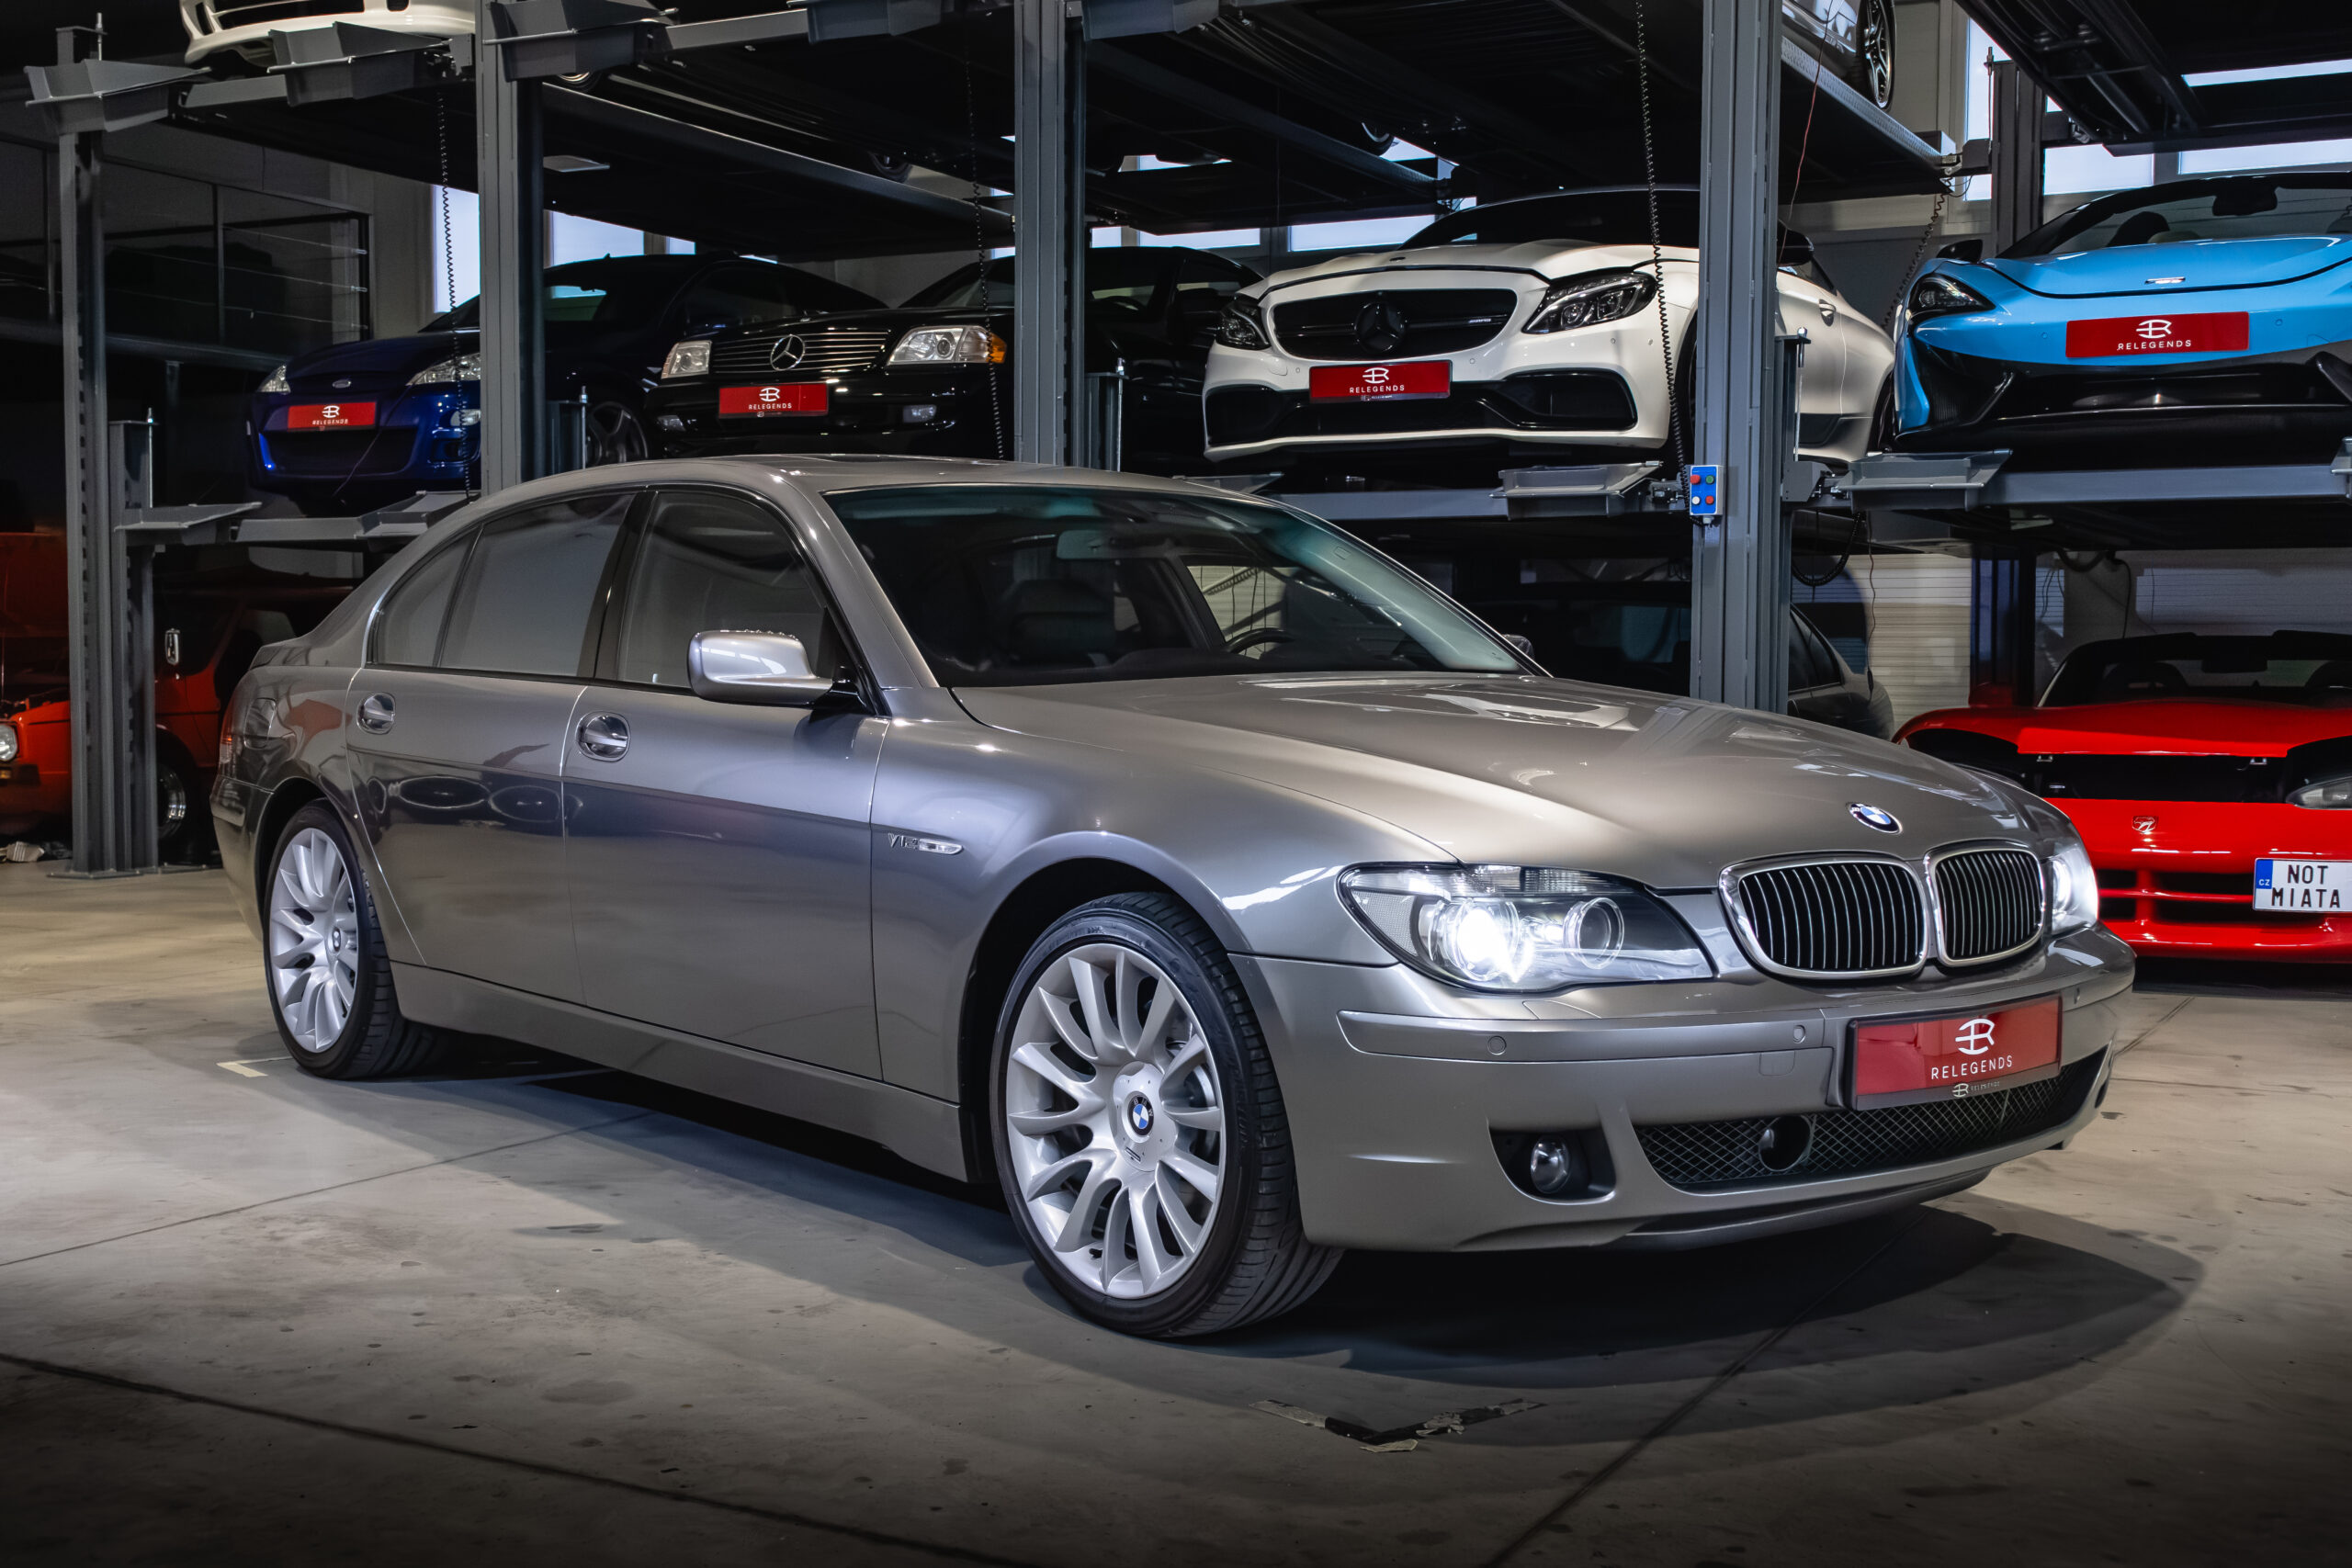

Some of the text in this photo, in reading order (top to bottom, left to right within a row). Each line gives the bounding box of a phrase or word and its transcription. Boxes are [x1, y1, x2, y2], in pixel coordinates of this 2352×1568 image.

[2117, 339, 2192, 351] RELEGENDS
[1349, 384, 1406, 394] RELEGENDS
[748, 402, 792, 411] RELEGENDS
[2258, 878, 2270, 886] CZ
[2287, 864, 2328, 885] NOT
[2271, 886, 2340, 908] MIATA
[1931, 1055, 2013, 1080] RELEGENDS
[1133, 1097, 1154, 1117] BMW
